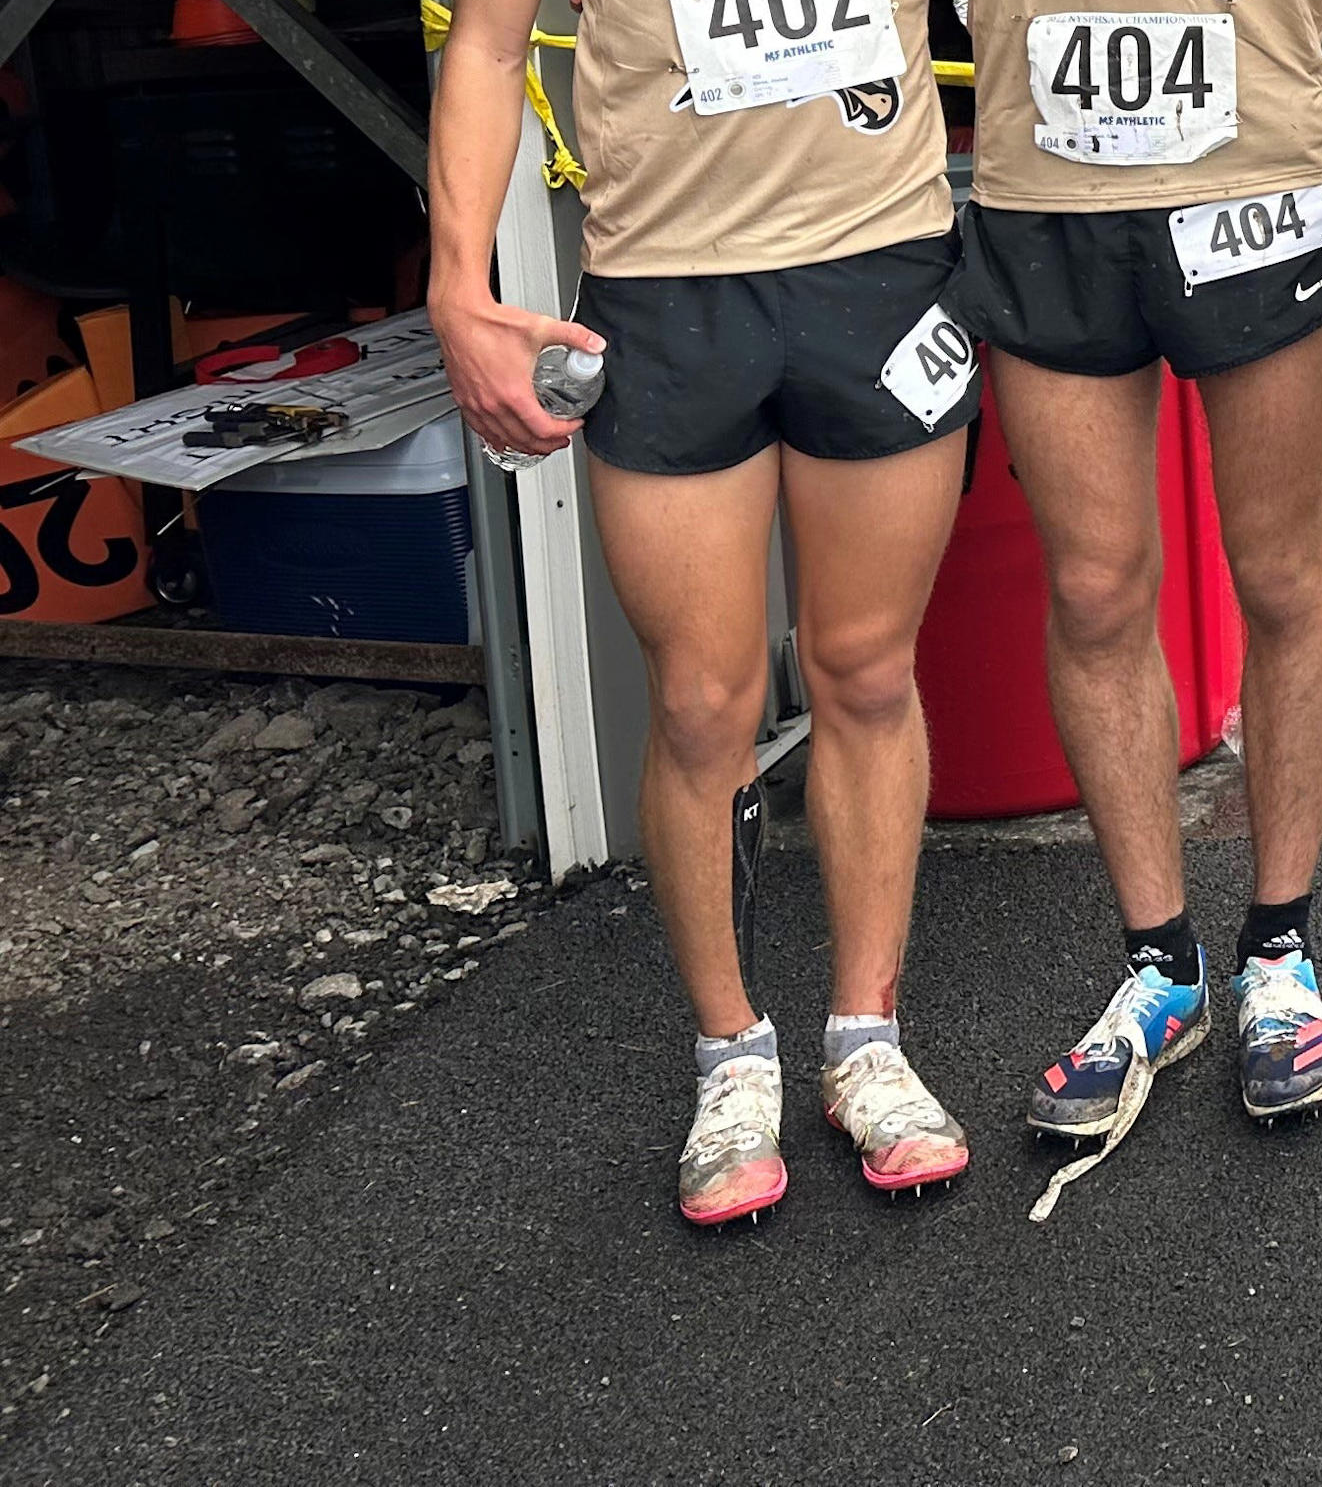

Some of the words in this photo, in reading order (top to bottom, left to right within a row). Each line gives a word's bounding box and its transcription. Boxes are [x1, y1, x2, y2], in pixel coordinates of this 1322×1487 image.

[782, 39, 835, 61] ATHLETIC
[1051, 25, 1213, 111] 404
[700, 87, 724, 104] 402
[1040, 137, 1060, 150] 404
[1209, 192, 1307, 258] 404
[915, 321, 969, 386] 40
[743, 802, 760, 822] KT
